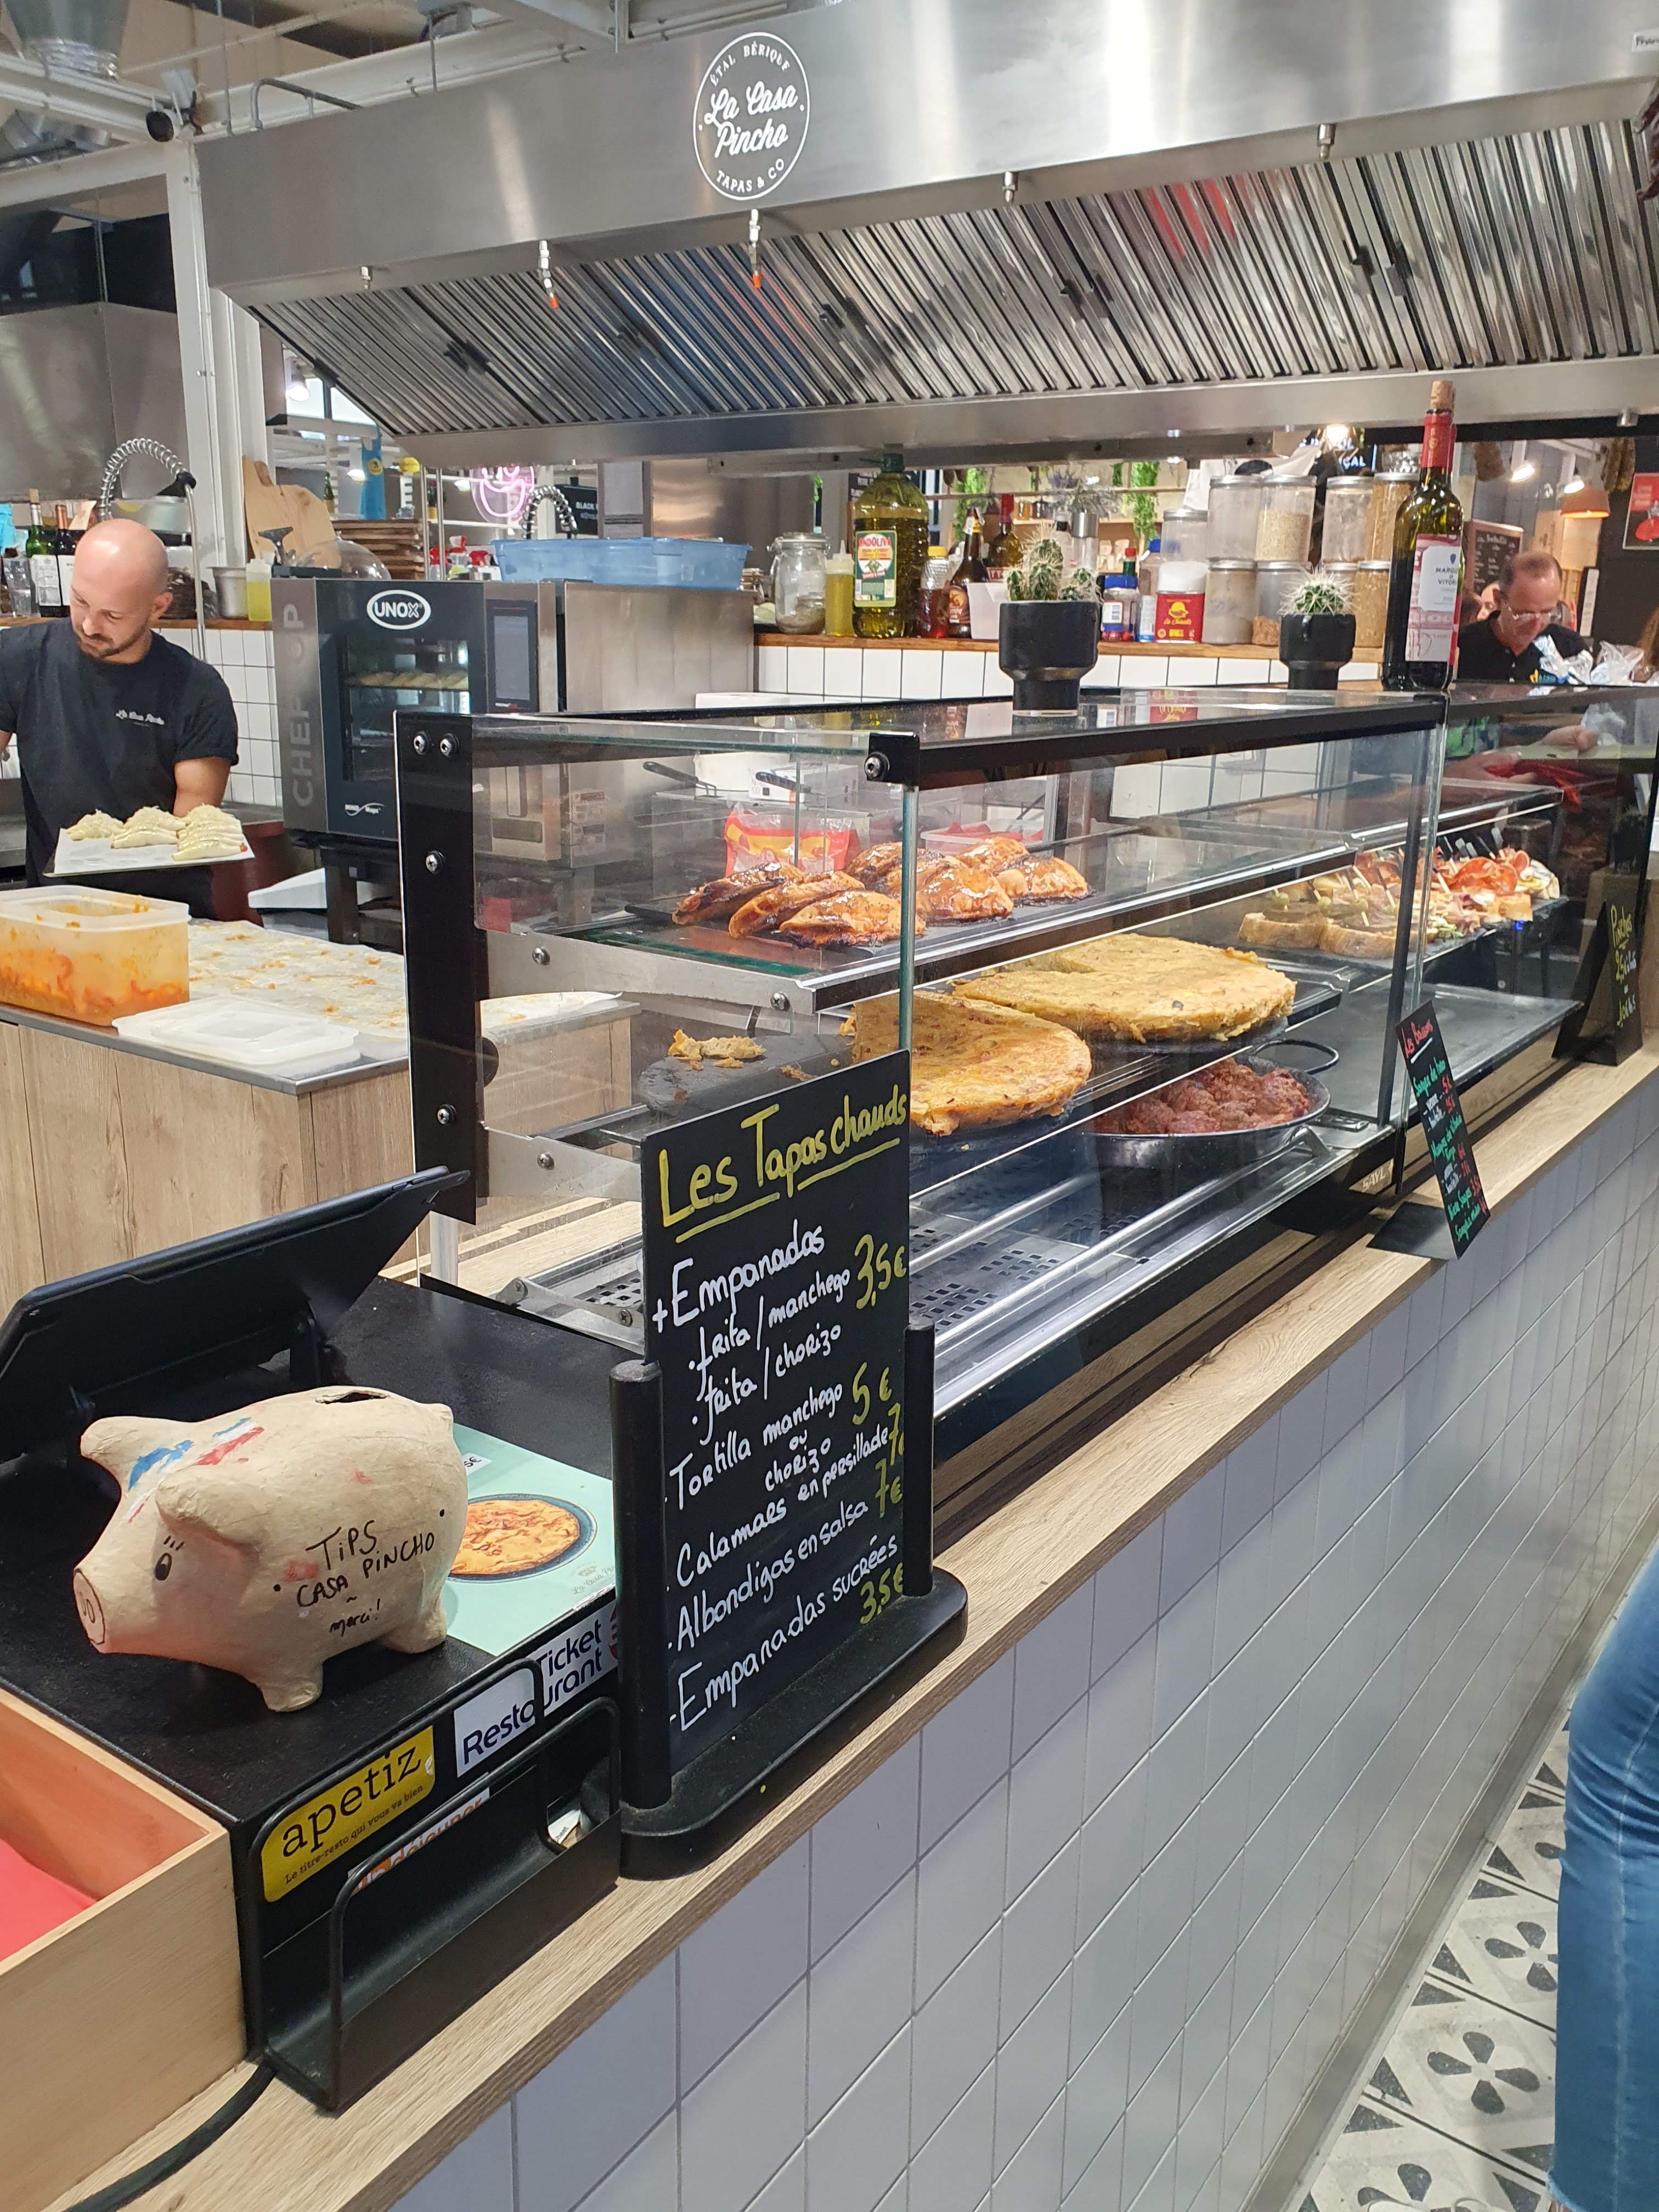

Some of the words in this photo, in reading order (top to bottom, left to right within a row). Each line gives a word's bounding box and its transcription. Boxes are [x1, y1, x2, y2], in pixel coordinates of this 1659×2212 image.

[704, 88, 740, 127] La
[746, 81, 798, 115] Casa
[714, 118, 788, 158] Pincho
[716, 170, 752, 193] TAPAS
[768, 158, 785, 179] CO
[374, 601, 419, 618] UNOX
[659, 1149, 738, 1227] Les
[741, 1103, 826, 1198] Tapas
[831, 1084, 907, 1154] chauds
[1362, 1167, 1386, 1193] SAYL
[669, 1430, 752, 1510] Tortilla
[763, 1383, 843, 1446] manchego
[765, 1437, 831, 1492] chorizo
[789, 1429, 808, 1451] ou
[798, 1478, 819, 1502] en
[822, 1423, 889, 1498] persillade
[297, 1575, 349, 1608] CASA
[677, 1548, 795, 1652] Albondigas
[798, 1534, 818, 1560] en
[819, 1500, 869, 1545] salsa
[281, 1745, 422, 1858] apetiz
[284, 1871, 297, 1884] Le
[300, 1837, 349, 1872] titre-resto
[351, 1824, 366, 1841] qui
[368, 1810, 390, 1827] vous
[390, 1799, 402, 1810] va
[404, 1784, 424, 1803] bien
